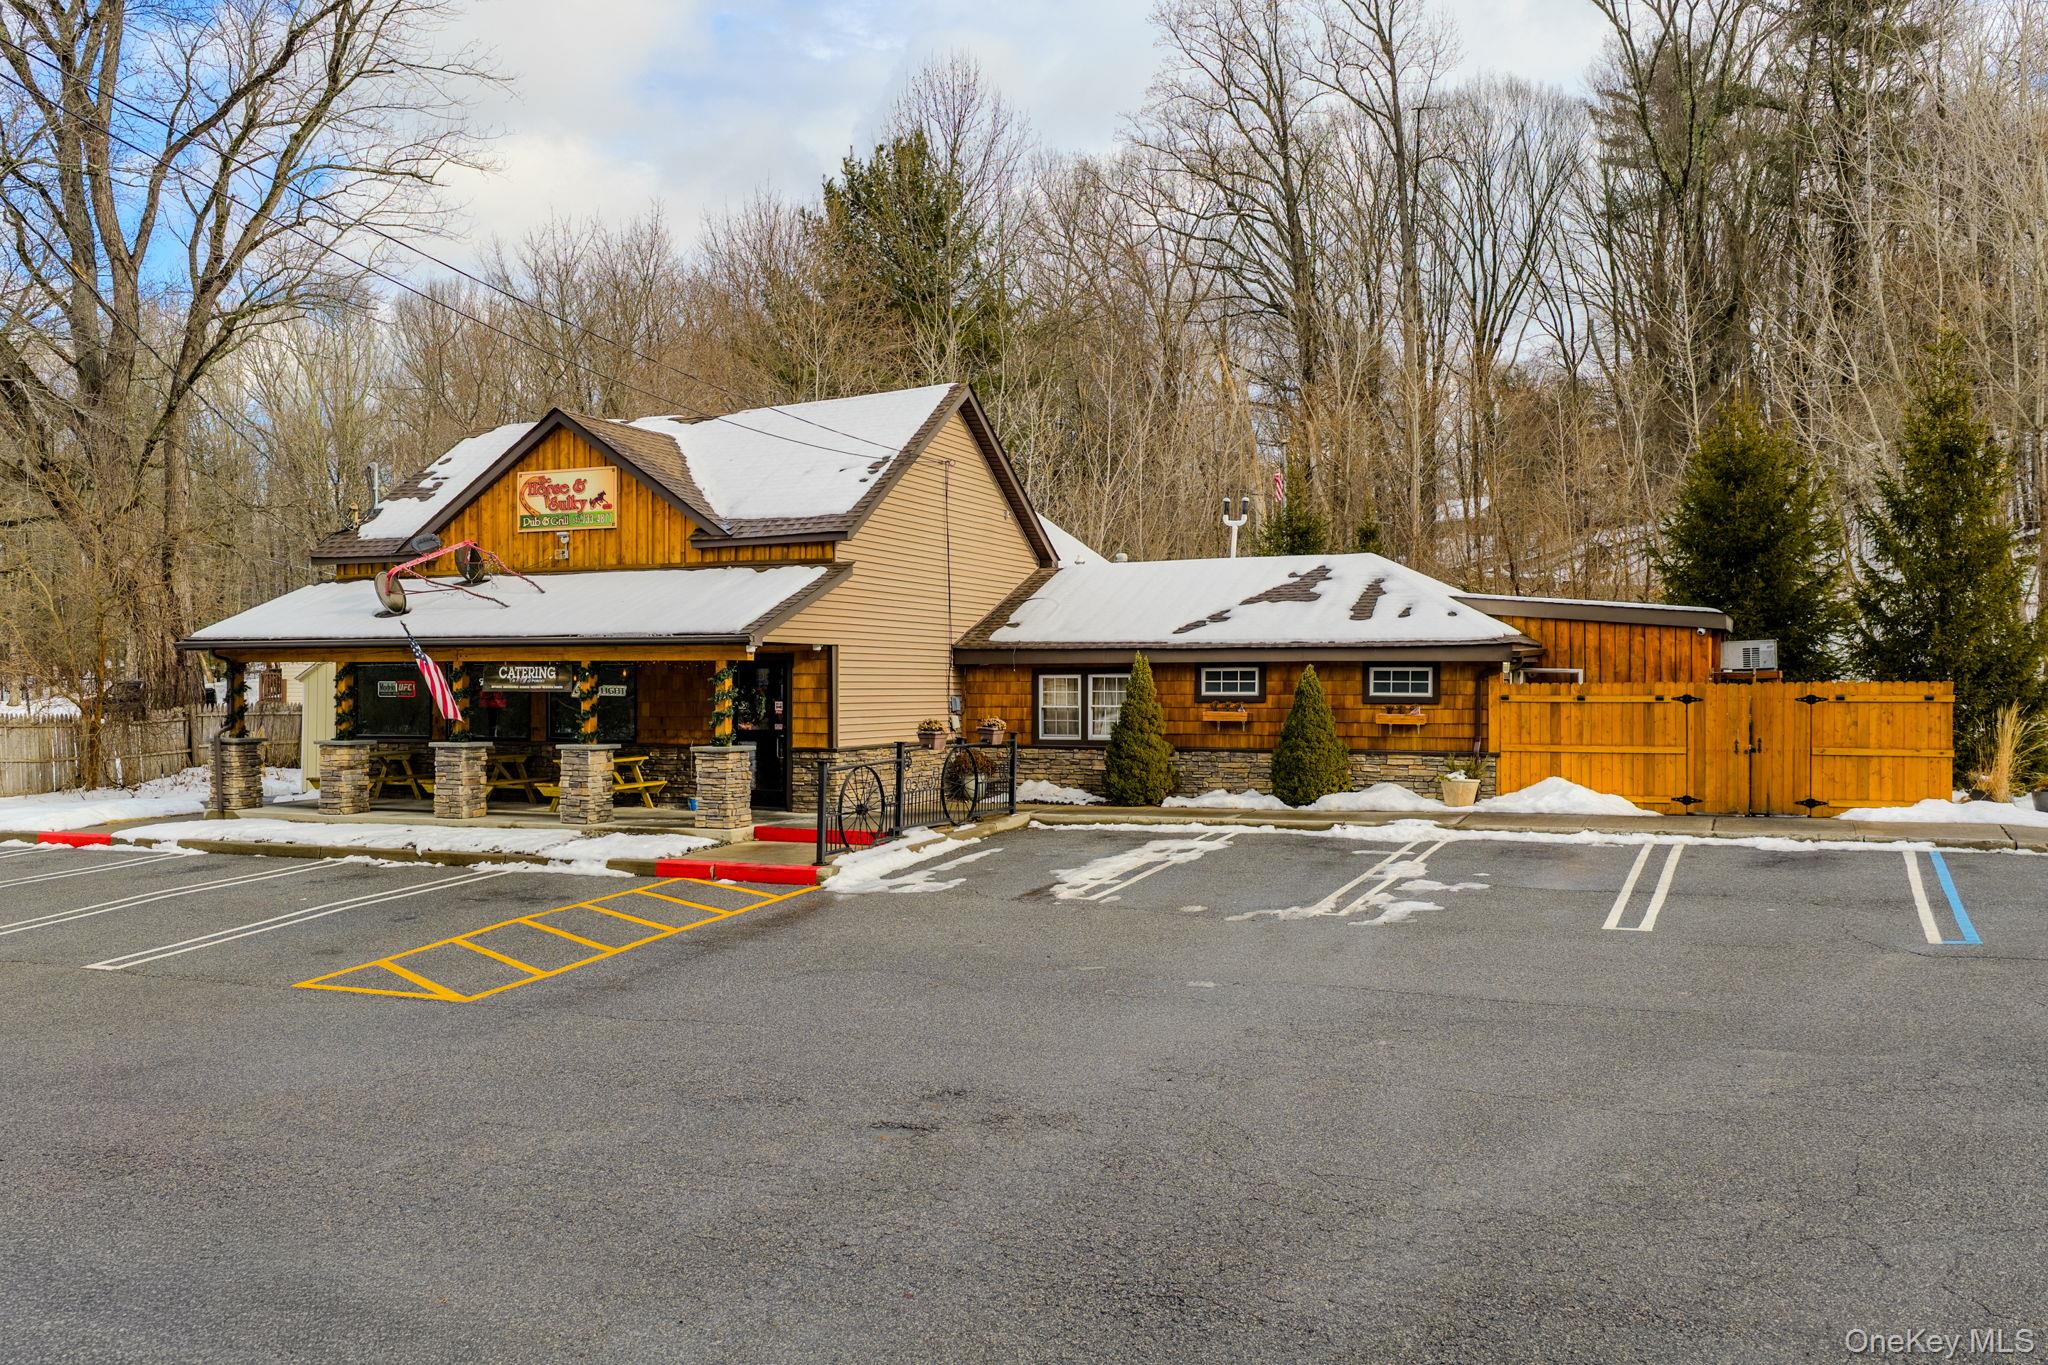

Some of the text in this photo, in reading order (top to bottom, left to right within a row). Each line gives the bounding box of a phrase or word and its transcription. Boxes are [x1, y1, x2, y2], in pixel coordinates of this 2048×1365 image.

[528, 478, 587, 496] Horse &
[548, 495, 587, 514] Sulky
[523, 517, 540, 527] Pub
[542, 517, 550, 526] &
[551, 516, 569, 525] Grill
[498, 666, 556, 679] CATERING
[398, 683, 412, 691] UFC
[600, 687, 625, 695] LIGHT
